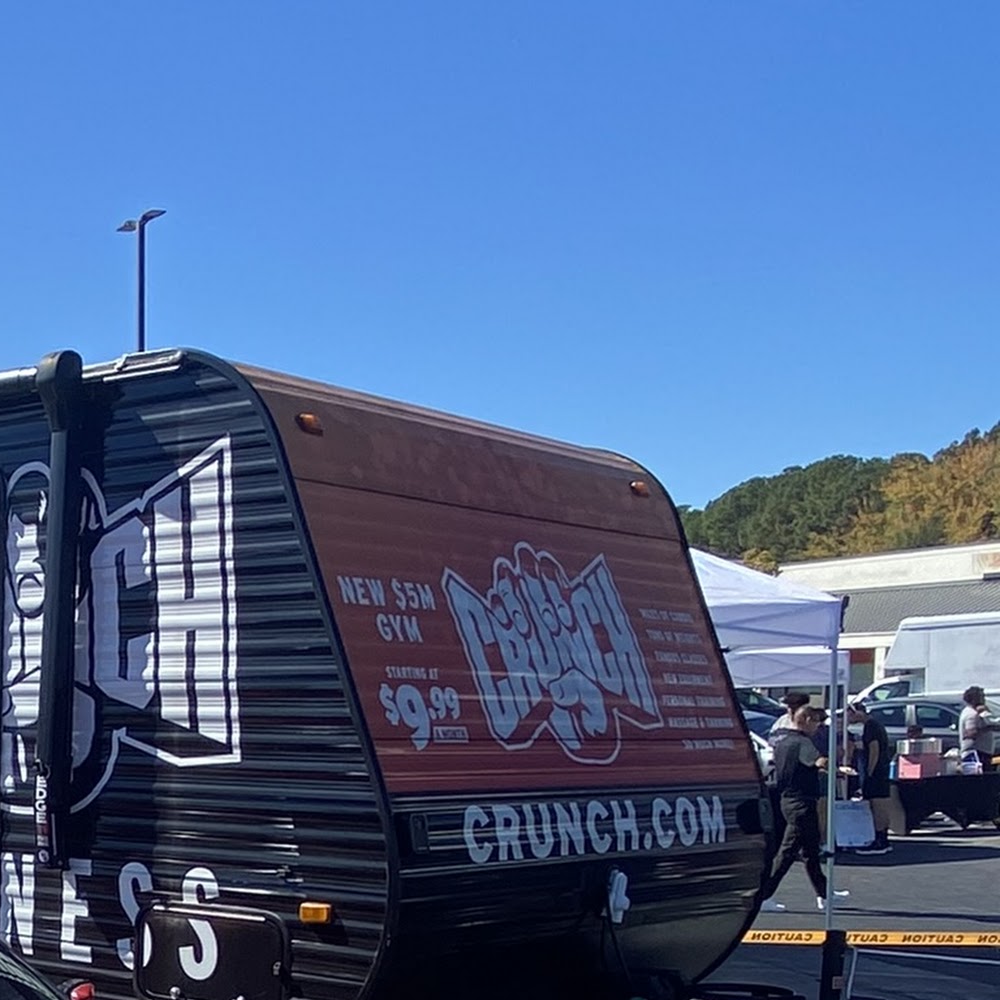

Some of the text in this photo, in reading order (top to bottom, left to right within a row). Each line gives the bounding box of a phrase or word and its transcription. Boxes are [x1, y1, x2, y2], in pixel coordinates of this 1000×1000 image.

[337, 575, 436, 611] NEW $5M
[376, 613, 424, 643] GYM
[385, 666, 427, 680] STARTING
[379, 683, 460, 751] $9.99
[463, 795, 726, 864] CRUNCH.COM
